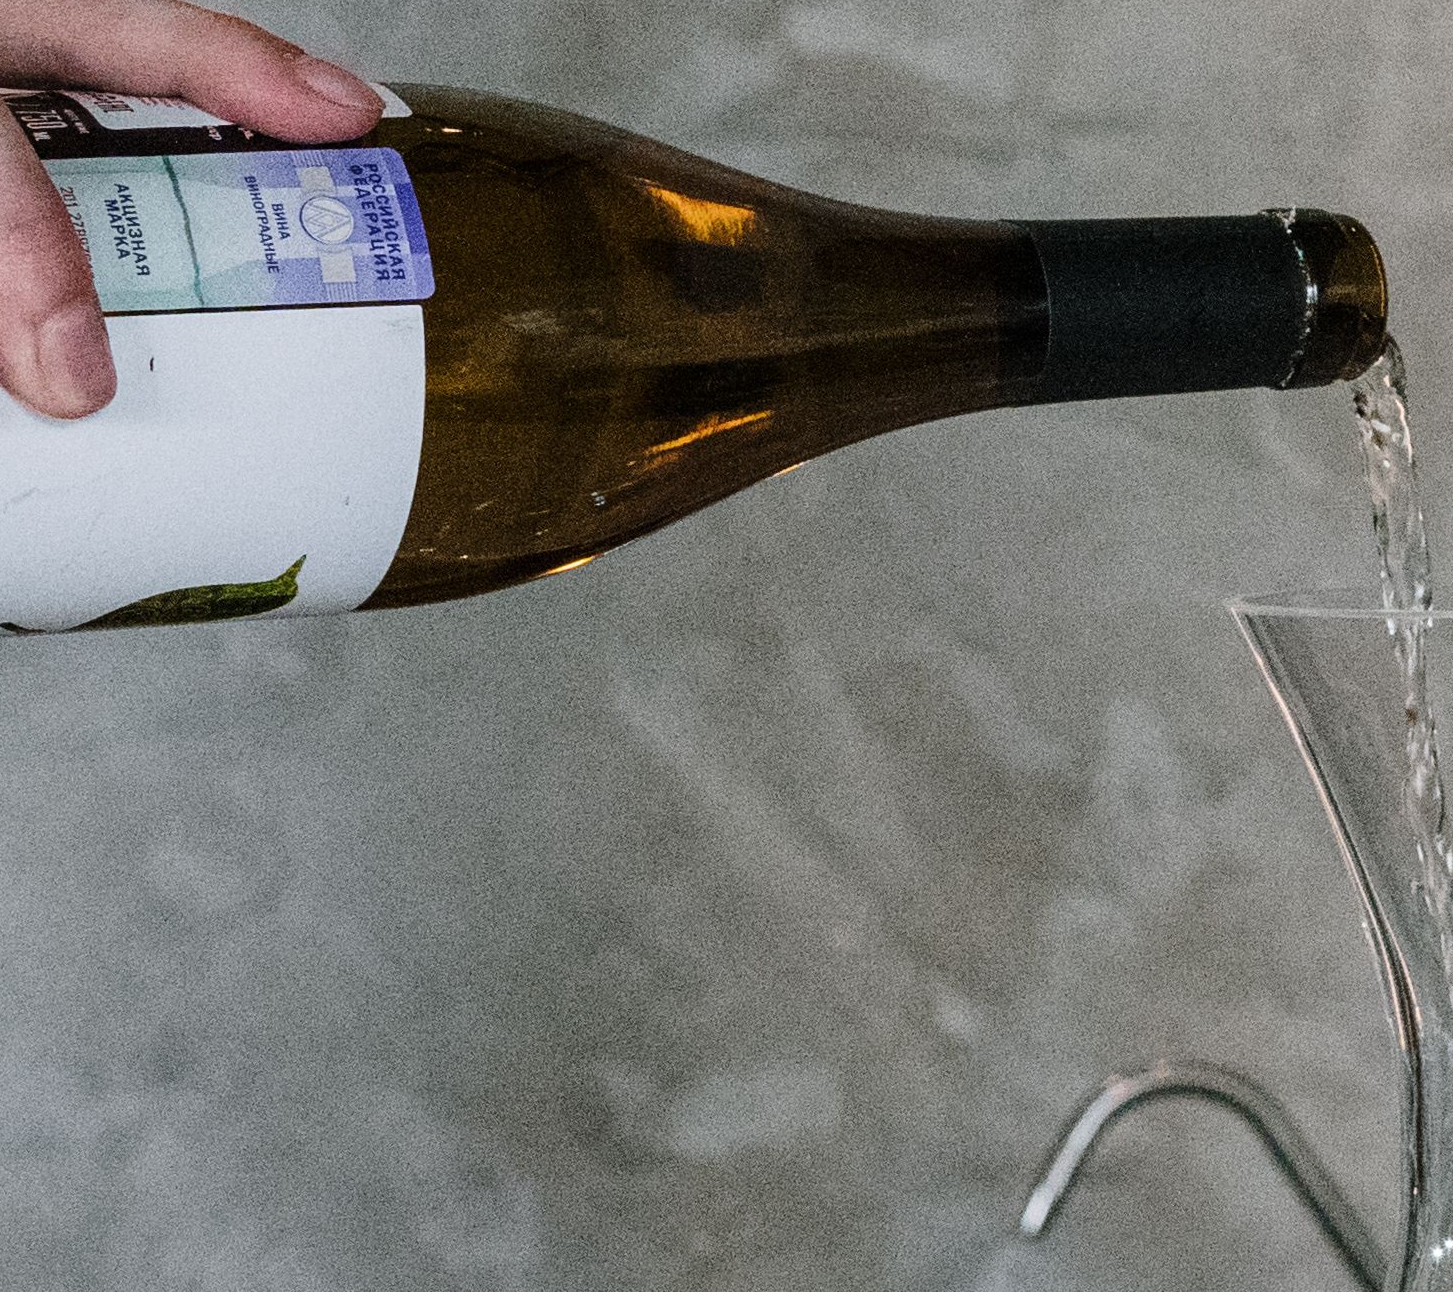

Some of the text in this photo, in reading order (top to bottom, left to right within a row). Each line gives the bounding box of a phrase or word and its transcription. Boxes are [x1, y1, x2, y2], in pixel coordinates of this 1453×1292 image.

[15, 109, 68, 130] 750
[103, 198, 131, 260] МАРКА
[113, 183, 151, 276] АКЦИЗНАЯ
[244, 175, 280, 274] ВИНОГРАДНЫЕ
[271, 203, 291, 241] ВИНА
[349, 164, 391, 281] ФЕДЕРАЦИЯ
[363, 163, 406, 280] РОССИЙСКАЯ
